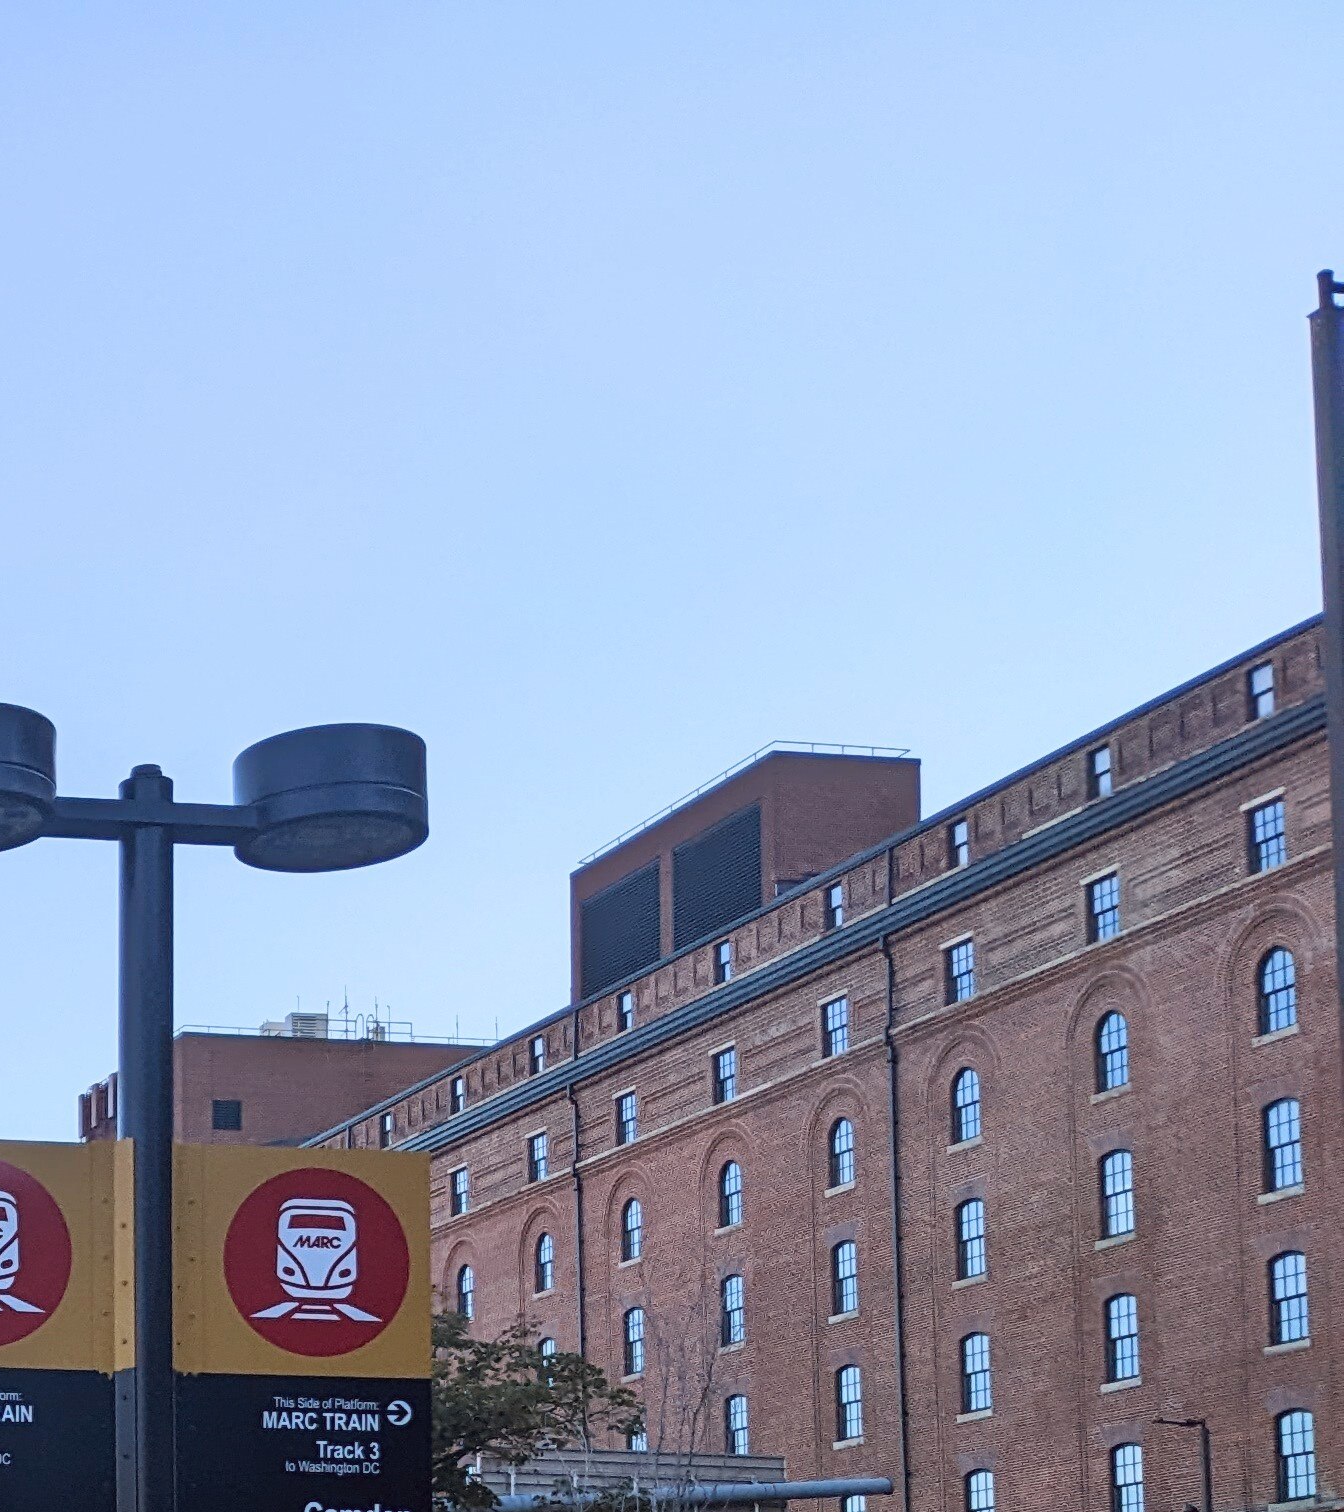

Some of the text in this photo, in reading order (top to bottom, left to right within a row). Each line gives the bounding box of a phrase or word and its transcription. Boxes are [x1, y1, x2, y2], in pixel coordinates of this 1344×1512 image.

[292, 1234, 342, 1249] MARC
[273, 1396, 379, 1410] This Side of Platform:
[262, 1411, 379, 1432] MARC TRAIN
[316, 1440, 380, 1460] Track 3
[285, 1461, 380, 1476] to Washington DC
